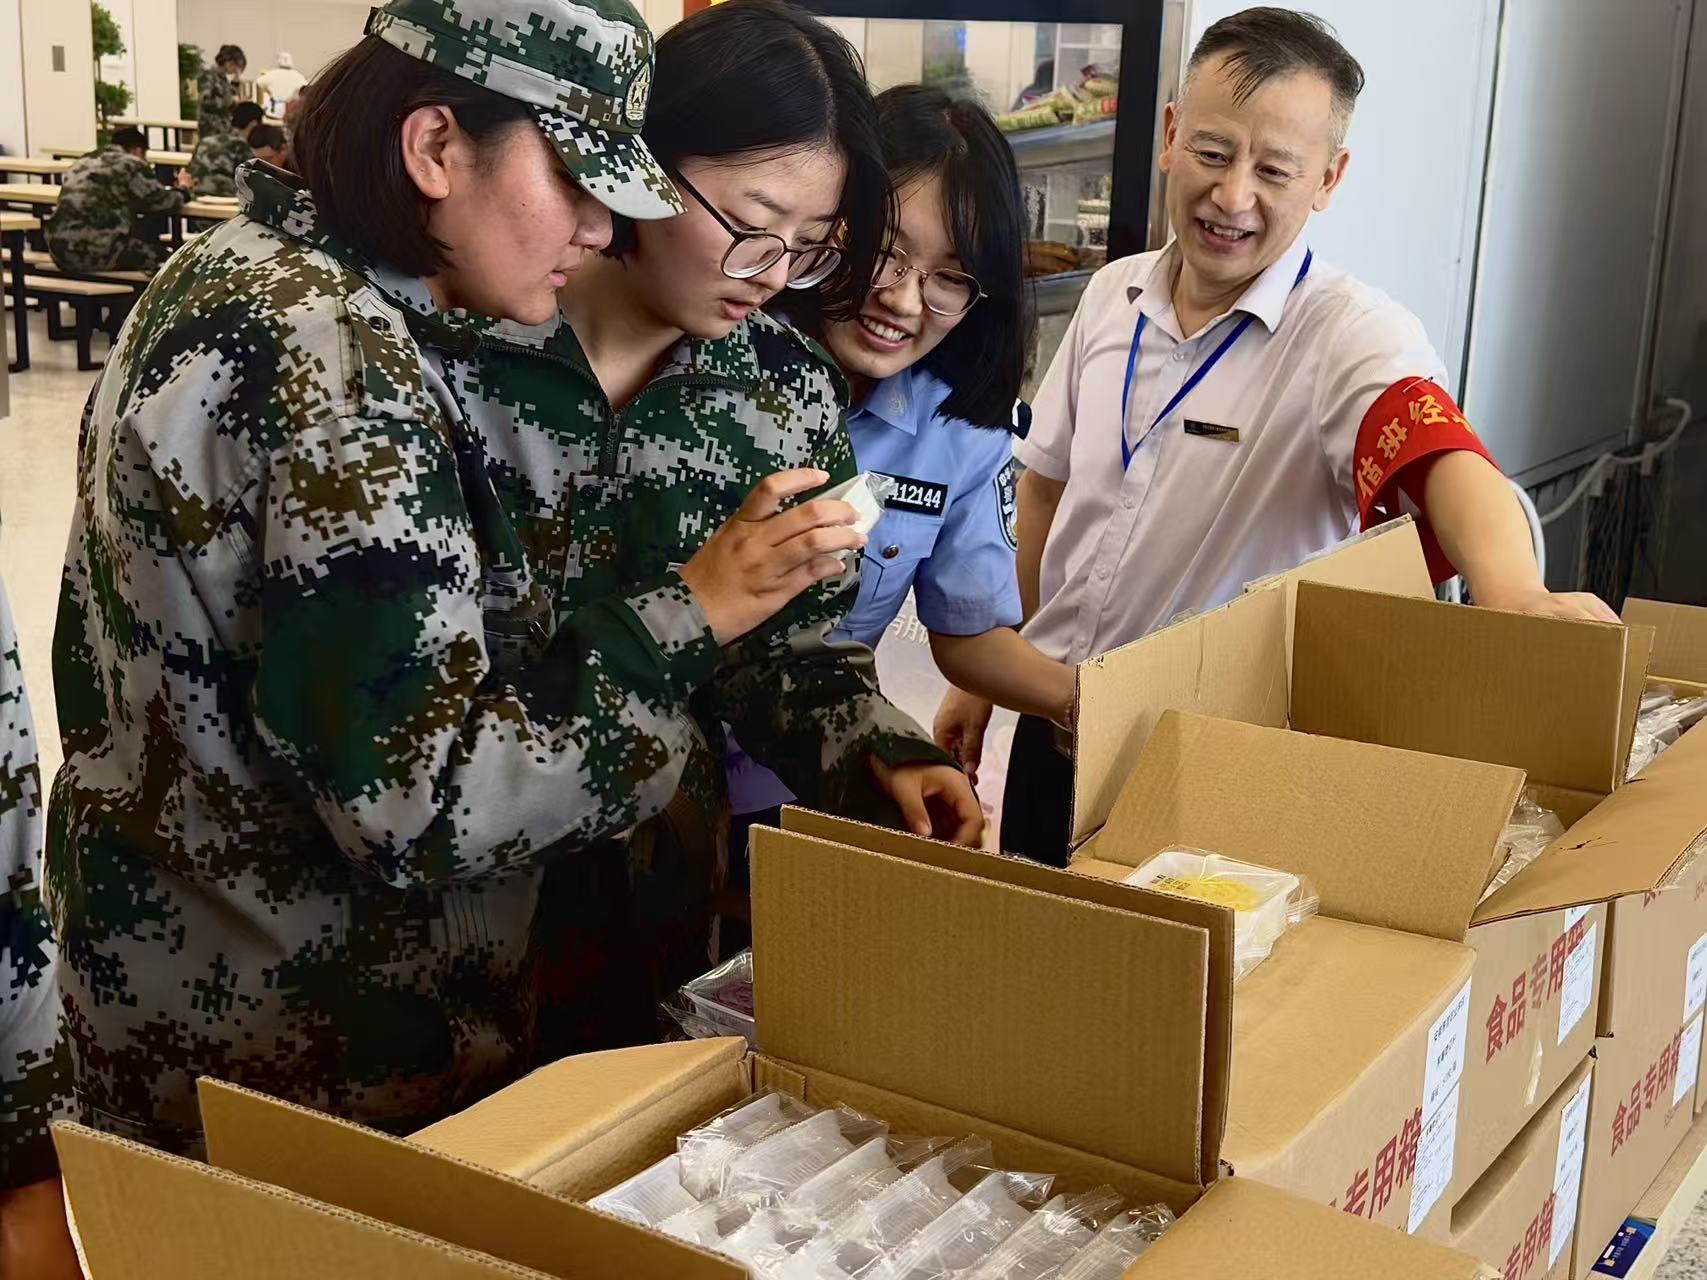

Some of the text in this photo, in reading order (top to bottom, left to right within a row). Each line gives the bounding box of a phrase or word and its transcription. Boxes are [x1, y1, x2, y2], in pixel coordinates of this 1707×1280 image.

[1329, 1106, 1423, 1219] 专用箱
[1498, 1190, 1556, 1280] 专用箱
